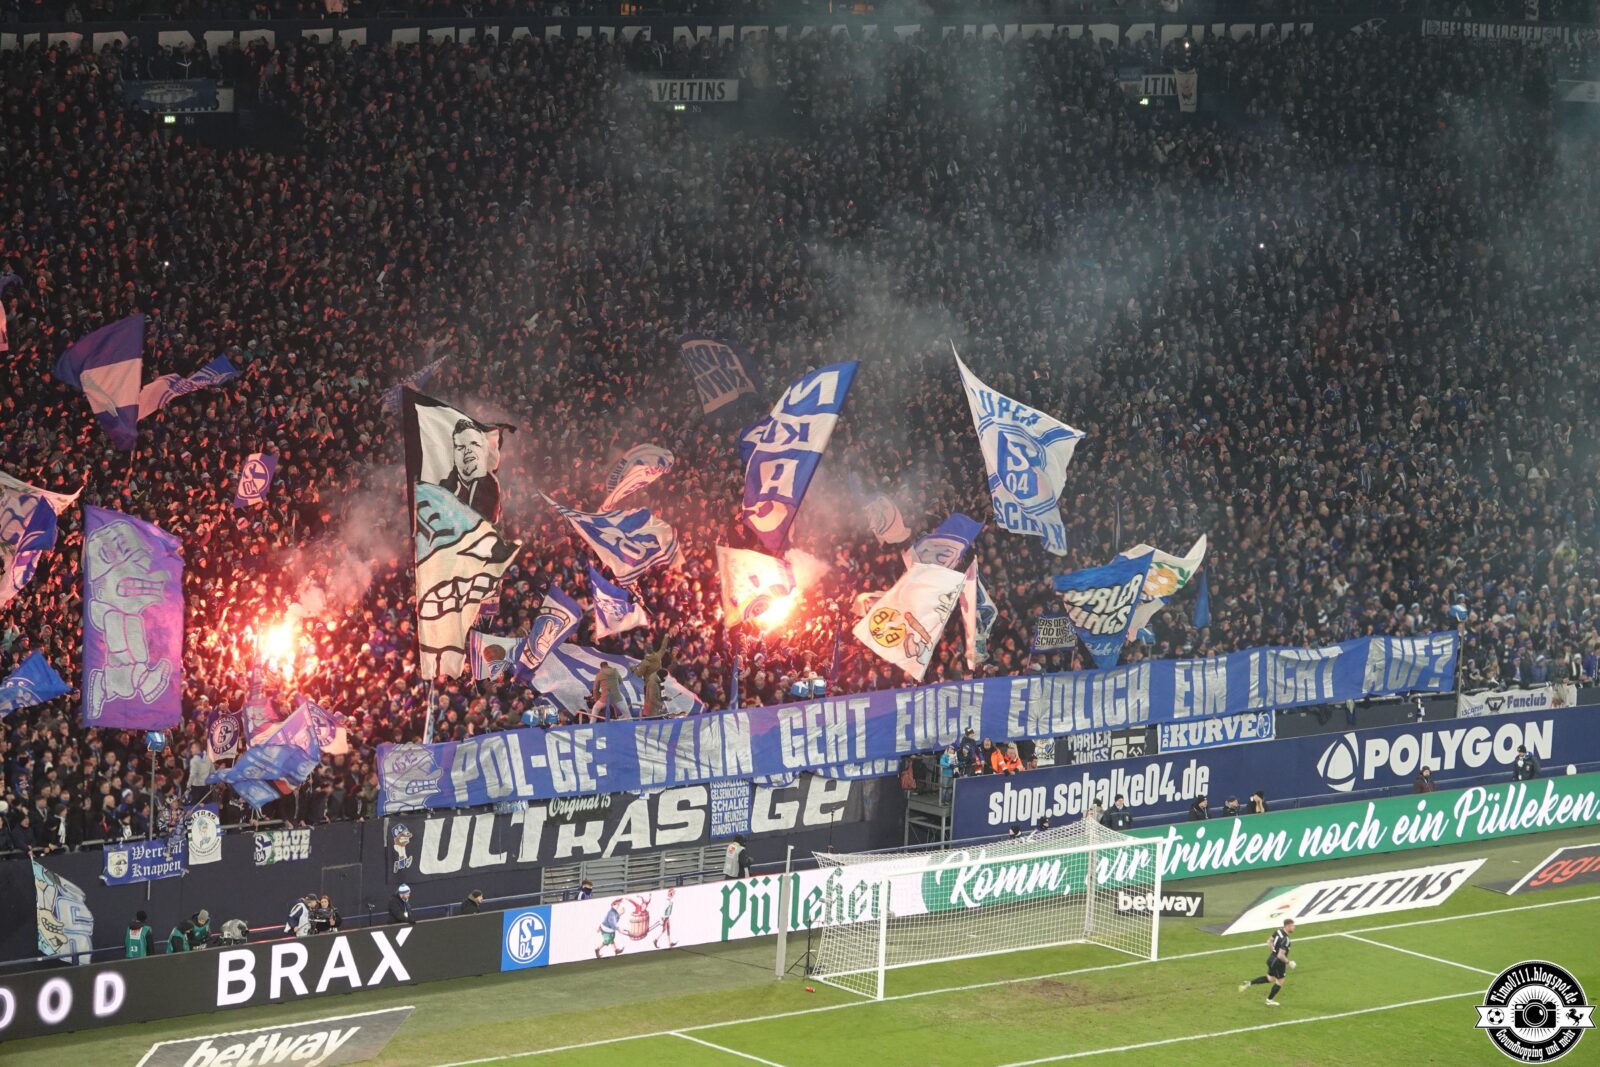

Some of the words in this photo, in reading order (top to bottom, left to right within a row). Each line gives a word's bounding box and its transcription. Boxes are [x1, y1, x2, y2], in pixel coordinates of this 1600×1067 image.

[657, 81, 726, 101] VELTINS
[1507, 692, 1547, 709] Fanclub
[450, 728, 607, 802] POL-GE:
[635, 711, 752, 785] WANN
[777, 697, 870, 769] GEHT
[896, 682, 984, 752] EUCH
[1007, 662, 1150, 738] ENDLICH
[1173, 656, 1228, 719] EIN
[1248, 646, 1343, 709] LICHT
[1362, 636, 1454, 694] AUF?
[1169, 713, 1256, 747] KURVE
[1363, 720, 1554, 780] POLYGON
[711, 786, 749, 800] GELSENKIRCHEN
[711, 797, 749, 812] SCHALKE
[987, 759, 1210, 826] shop.schalke04.de
[549, 796, 599, 821] Original
[711, 812, 723, 824] SEIT
[274, 830, 310, 846] BLUE
[1160, 818, 1292, 876] trinken
[1298, 802, 1387, 858] noch
[1392, 800, 1449, 845] ein
[274, 845, 310, 862] BOYZ
[131, 862, 182, 878] Knappen
[1118, 891, 1202, 917] betway
[1295, 867, 1466, 919] VELTINS
[216, 926, 413, 1007] BRAX
[184, 1026, 362, 1067] betway
